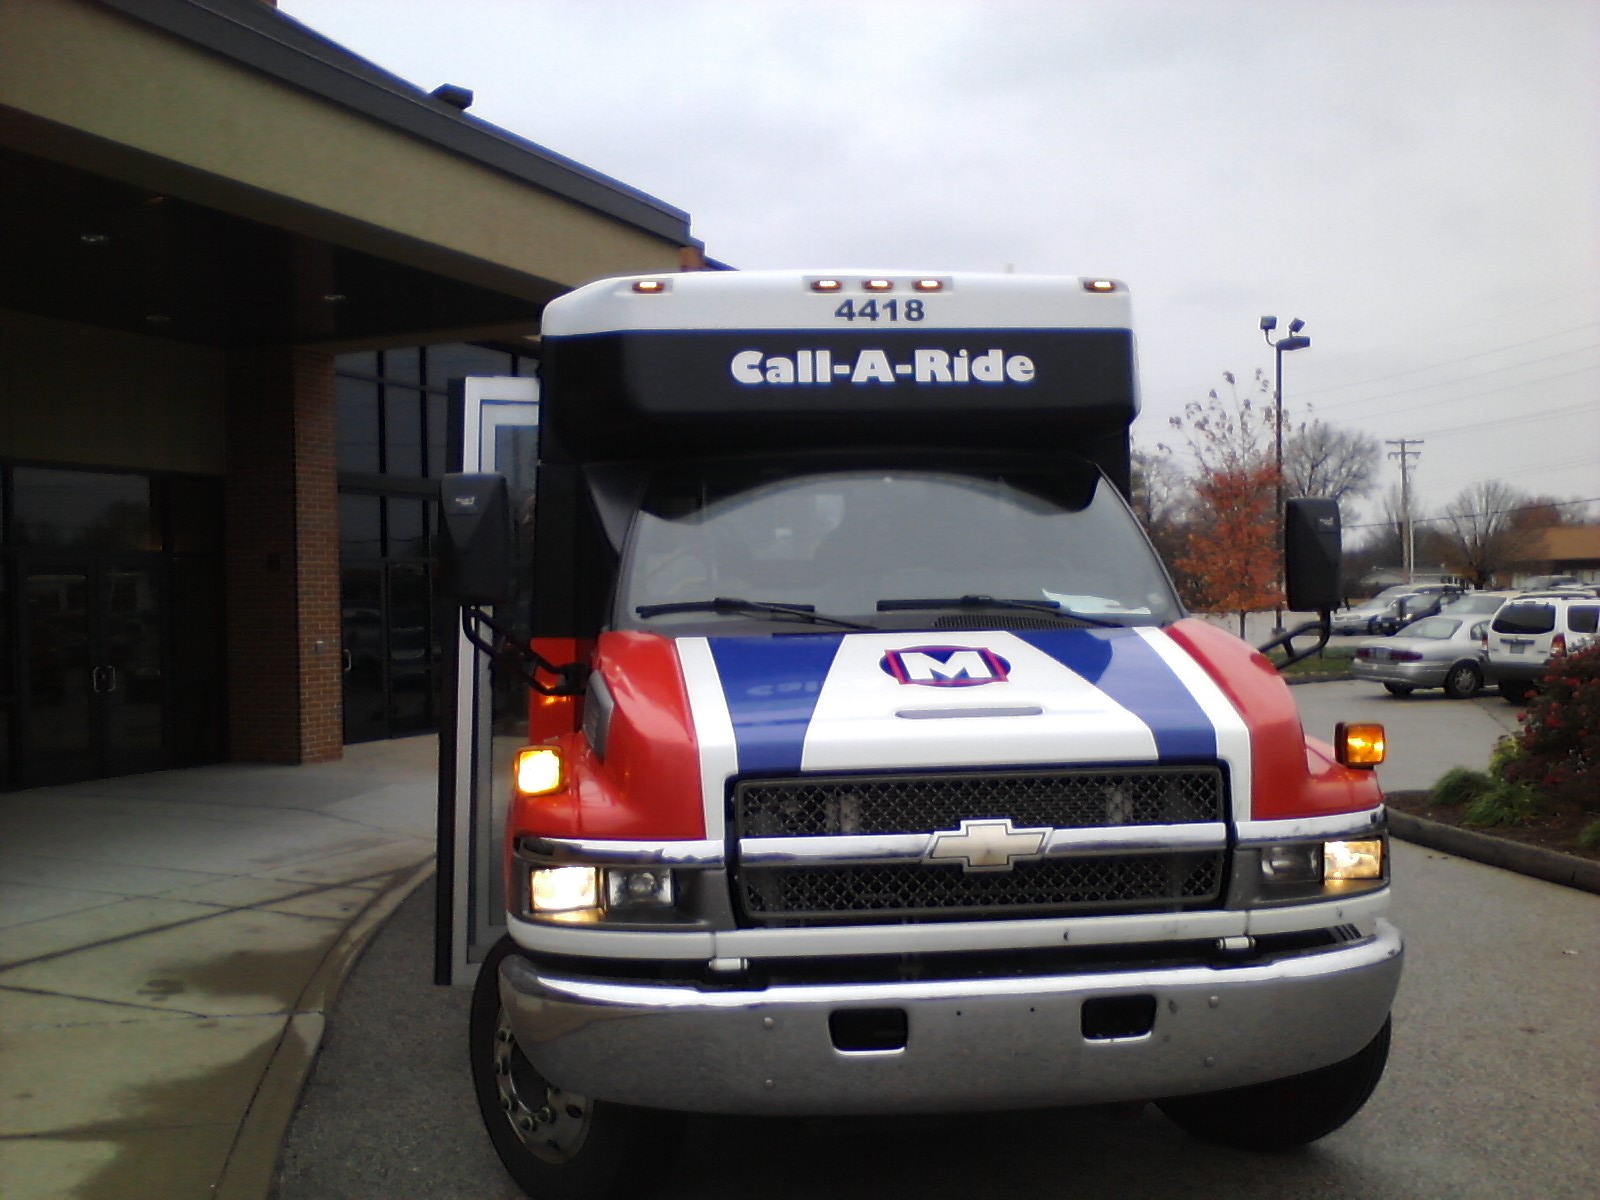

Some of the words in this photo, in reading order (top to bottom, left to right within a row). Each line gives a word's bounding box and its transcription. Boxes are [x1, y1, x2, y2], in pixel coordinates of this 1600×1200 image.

[833, 299, 925, 321] 4418
[731, 349, 1035, 384] Call-A-Ride
[900, 651, 992, 680] M
